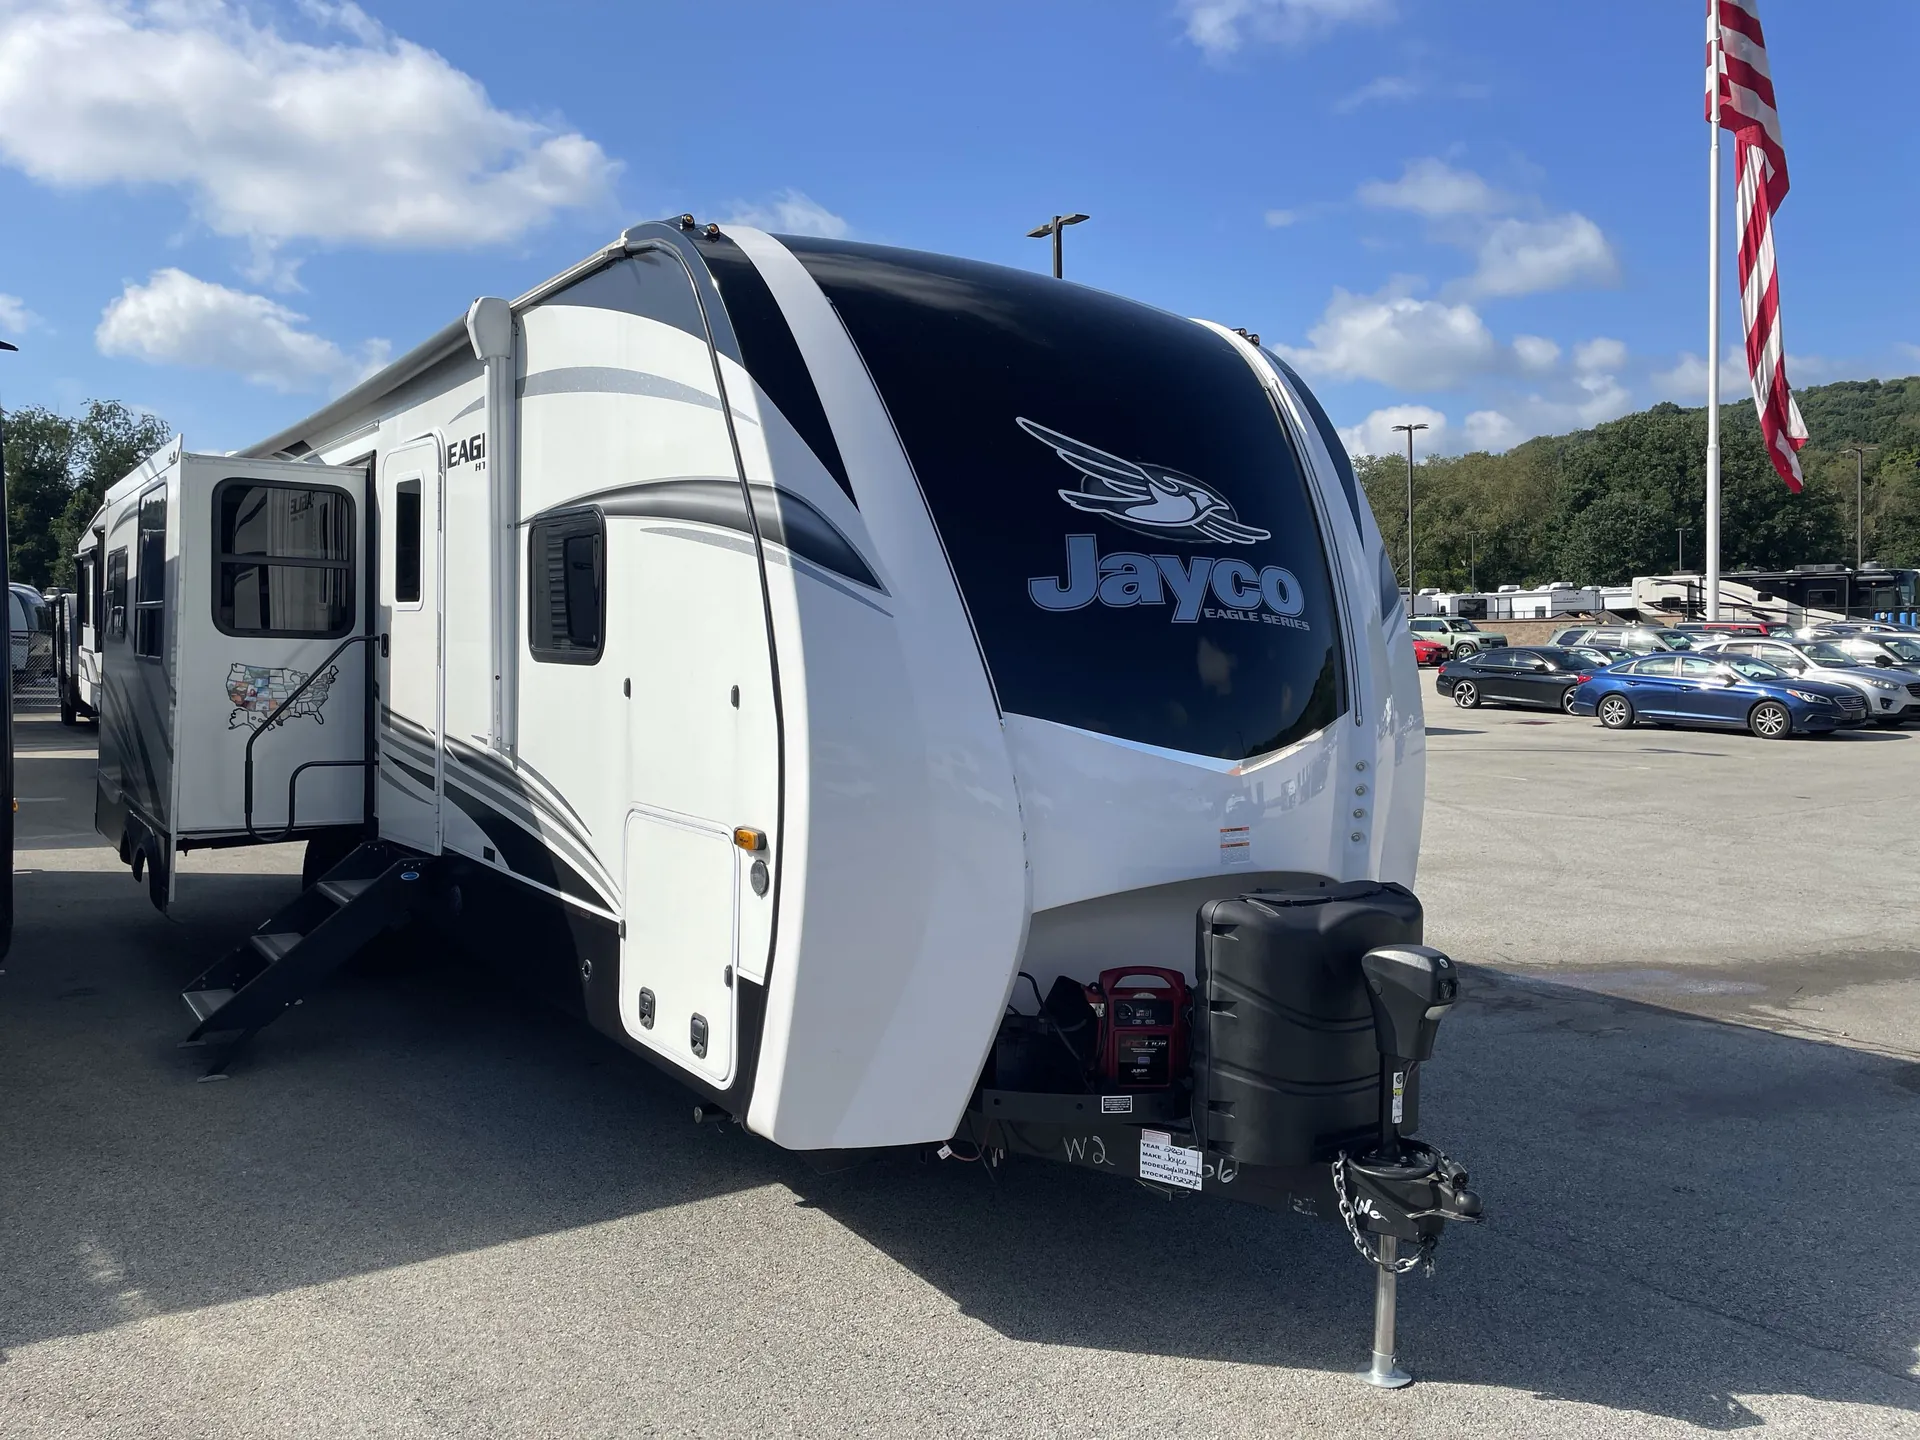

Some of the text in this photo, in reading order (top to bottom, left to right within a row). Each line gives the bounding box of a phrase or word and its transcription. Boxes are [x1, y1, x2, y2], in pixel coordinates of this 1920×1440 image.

[1028, 533, 1304, 623] Jayco
[1203, 608, 1311, 631] EAGLE SERIES
[1142, 1142, 1160, 1151] YEAR
[1142, 1151, 1162, 1160] MAKE
